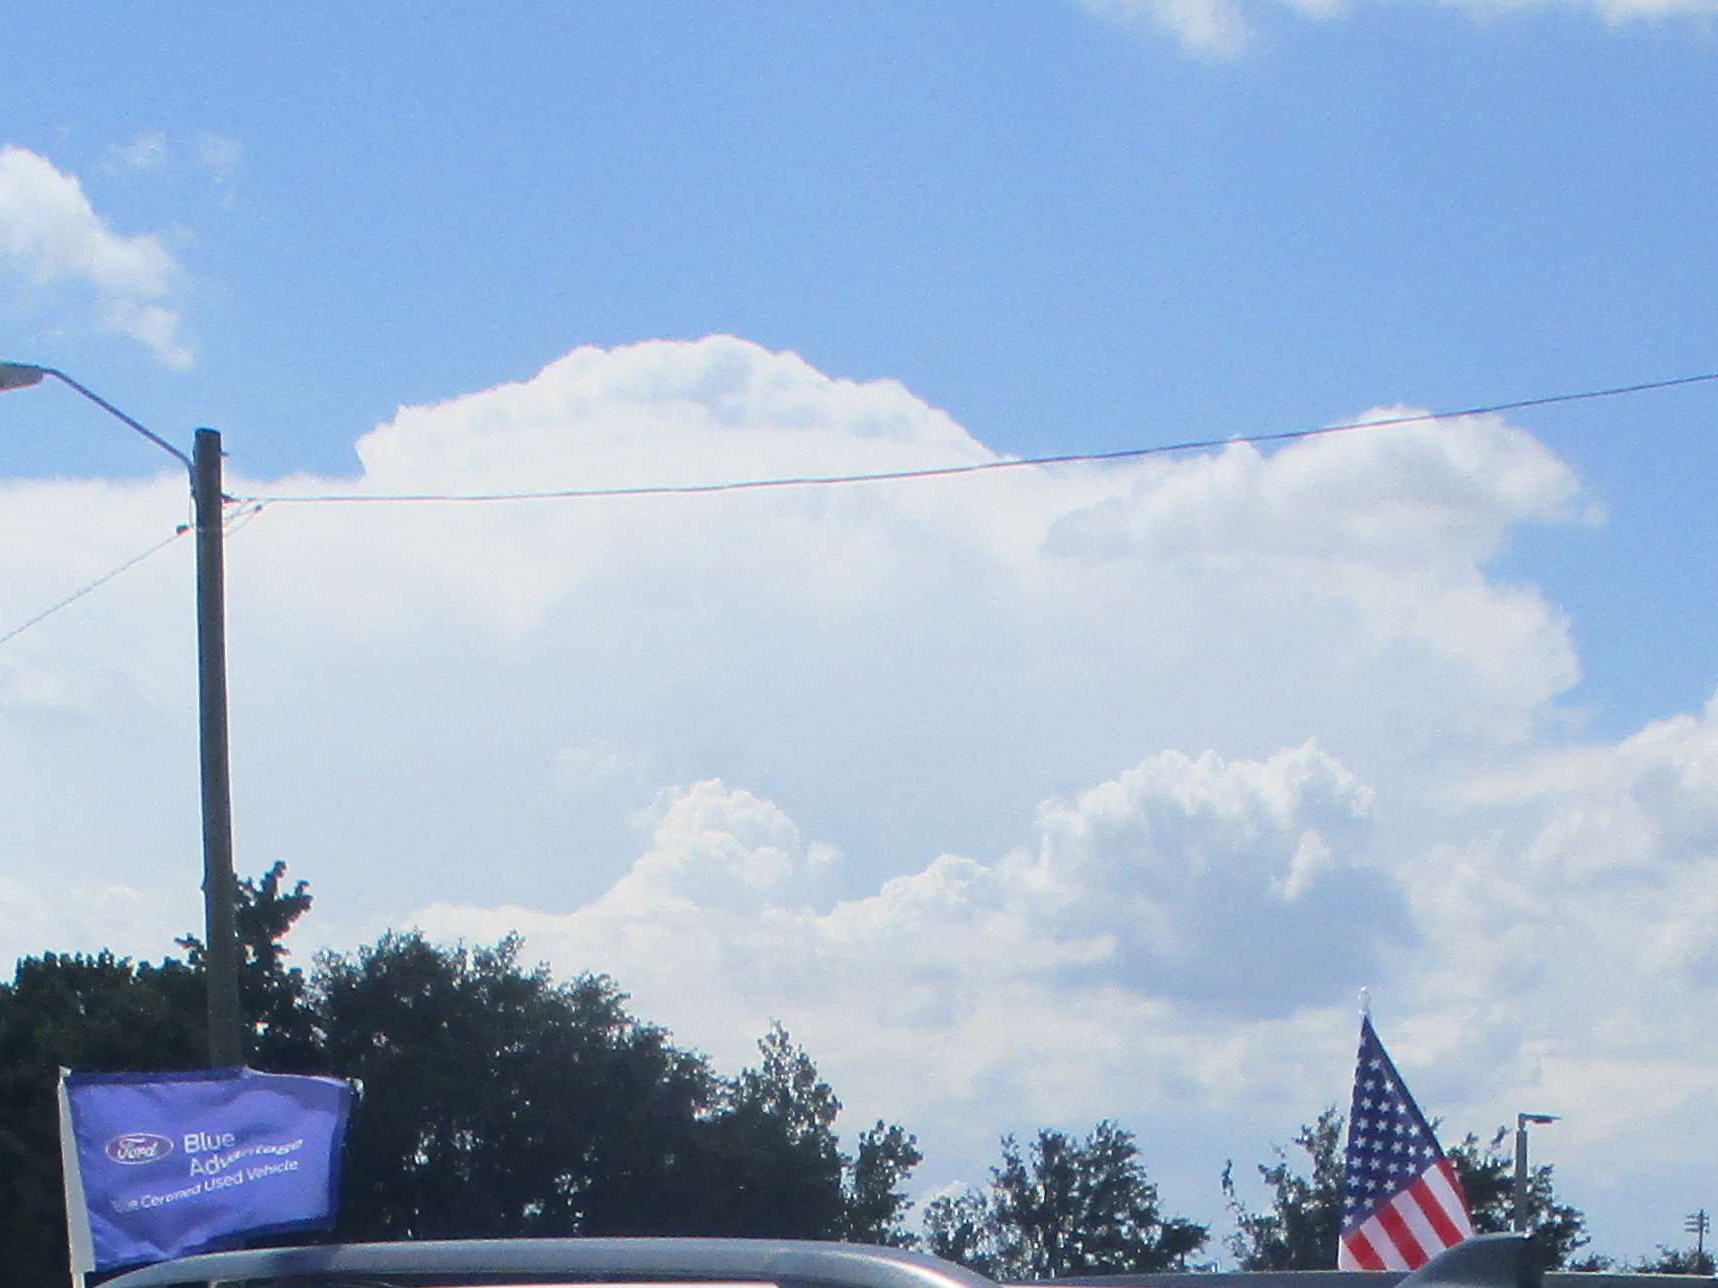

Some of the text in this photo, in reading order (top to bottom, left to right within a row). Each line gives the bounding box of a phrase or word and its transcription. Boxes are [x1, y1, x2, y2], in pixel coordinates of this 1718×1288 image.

[116, 1137, 159, 1160] Ford
[184, 1132, 234, 1154] Blue
[204, 1172, 244, 1193] Used
[246, 1159, 299, 1182] Vehicle
